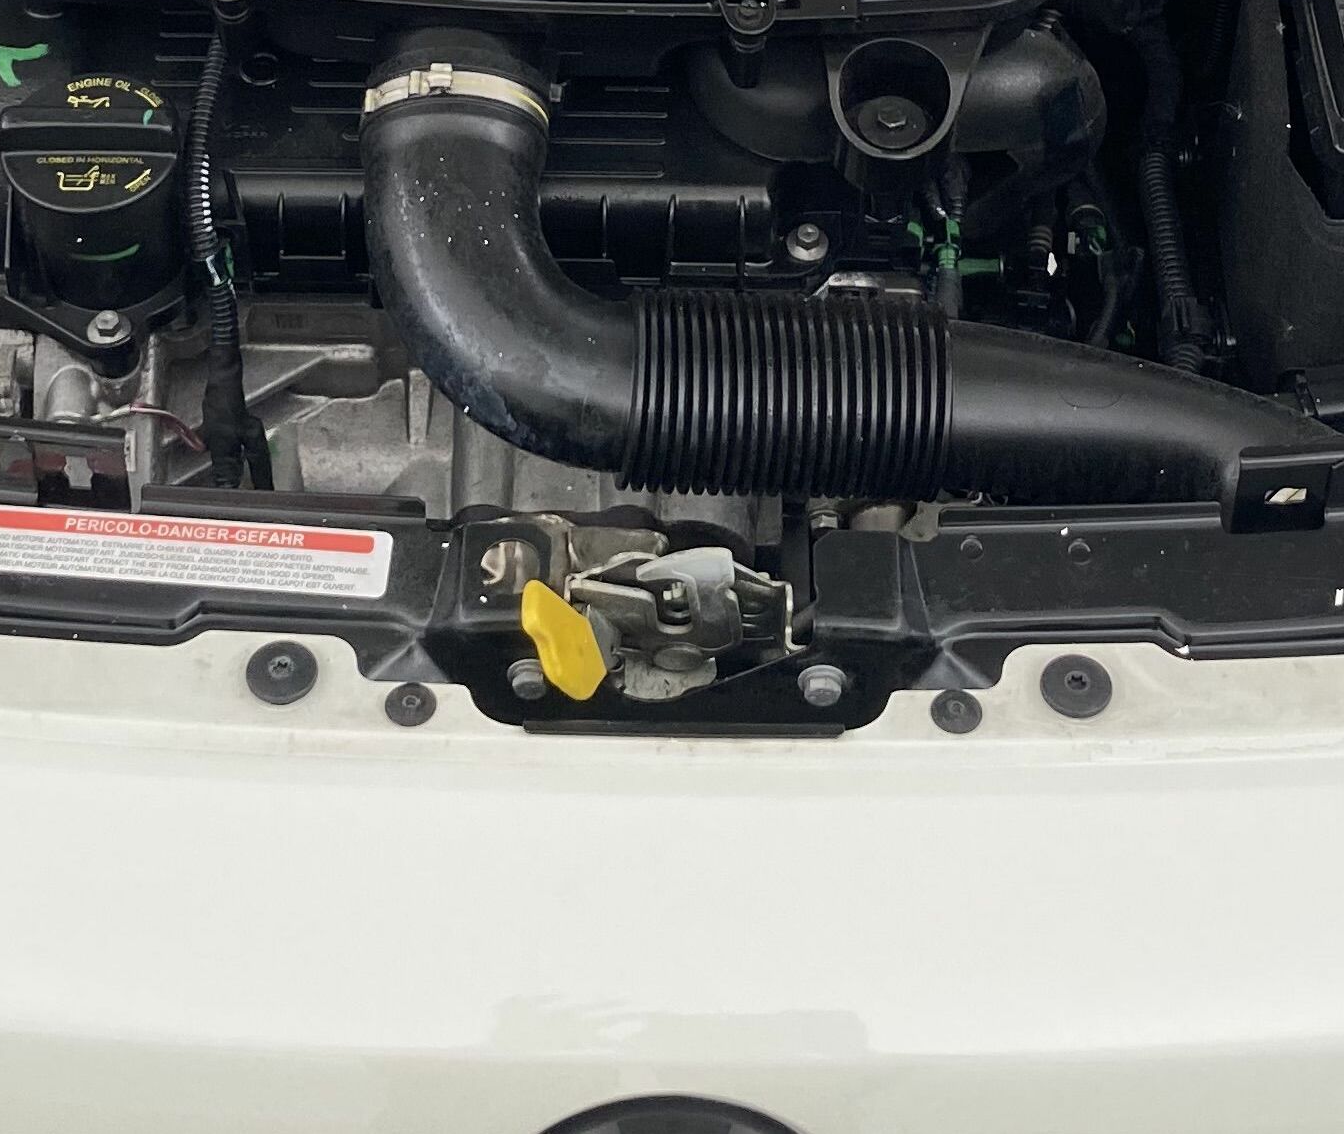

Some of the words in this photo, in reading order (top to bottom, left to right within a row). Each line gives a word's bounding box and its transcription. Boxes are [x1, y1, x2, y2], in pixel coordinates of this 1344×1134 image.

[67, 78, 113, 92] ENGINE
[114, 79, 130, 92] OIL
[36, 156, 74, 165] CLOSED
[75, 156, 86, 165] IN
[87, 156, 145, 165] HORIZONTAL
[63, 517, 305, 546] PERICOLO-DANGER-GEFAHR
[11, 533, 47, 543] MOTORE
[155, 544, 185, 553] CHIAVE
[187, 546, 201, 554] DAL
[202, 547, 237, 557] QUADRO
[245, 550, 279, 560] COFANO
[23, 559, 58, 570] MOTEUR
[198, 572, 236, 583] CONTACT
[237, 575, 265, 585] QUAND
[277, 578, 305, 588] CAPOT
[305, 580, 323, 590] EST
[93, 556, 129, 566] EXTRACT
[131, 559, 146, 567] THE
[148, 560, 165, 569] KEY
[164, 561, 189, 571] FROM
[190, 563, 240, 575] DASHBOARD
[240, 567, 266, 576] WHEN
[266, 569, 291, 578] HOOD
